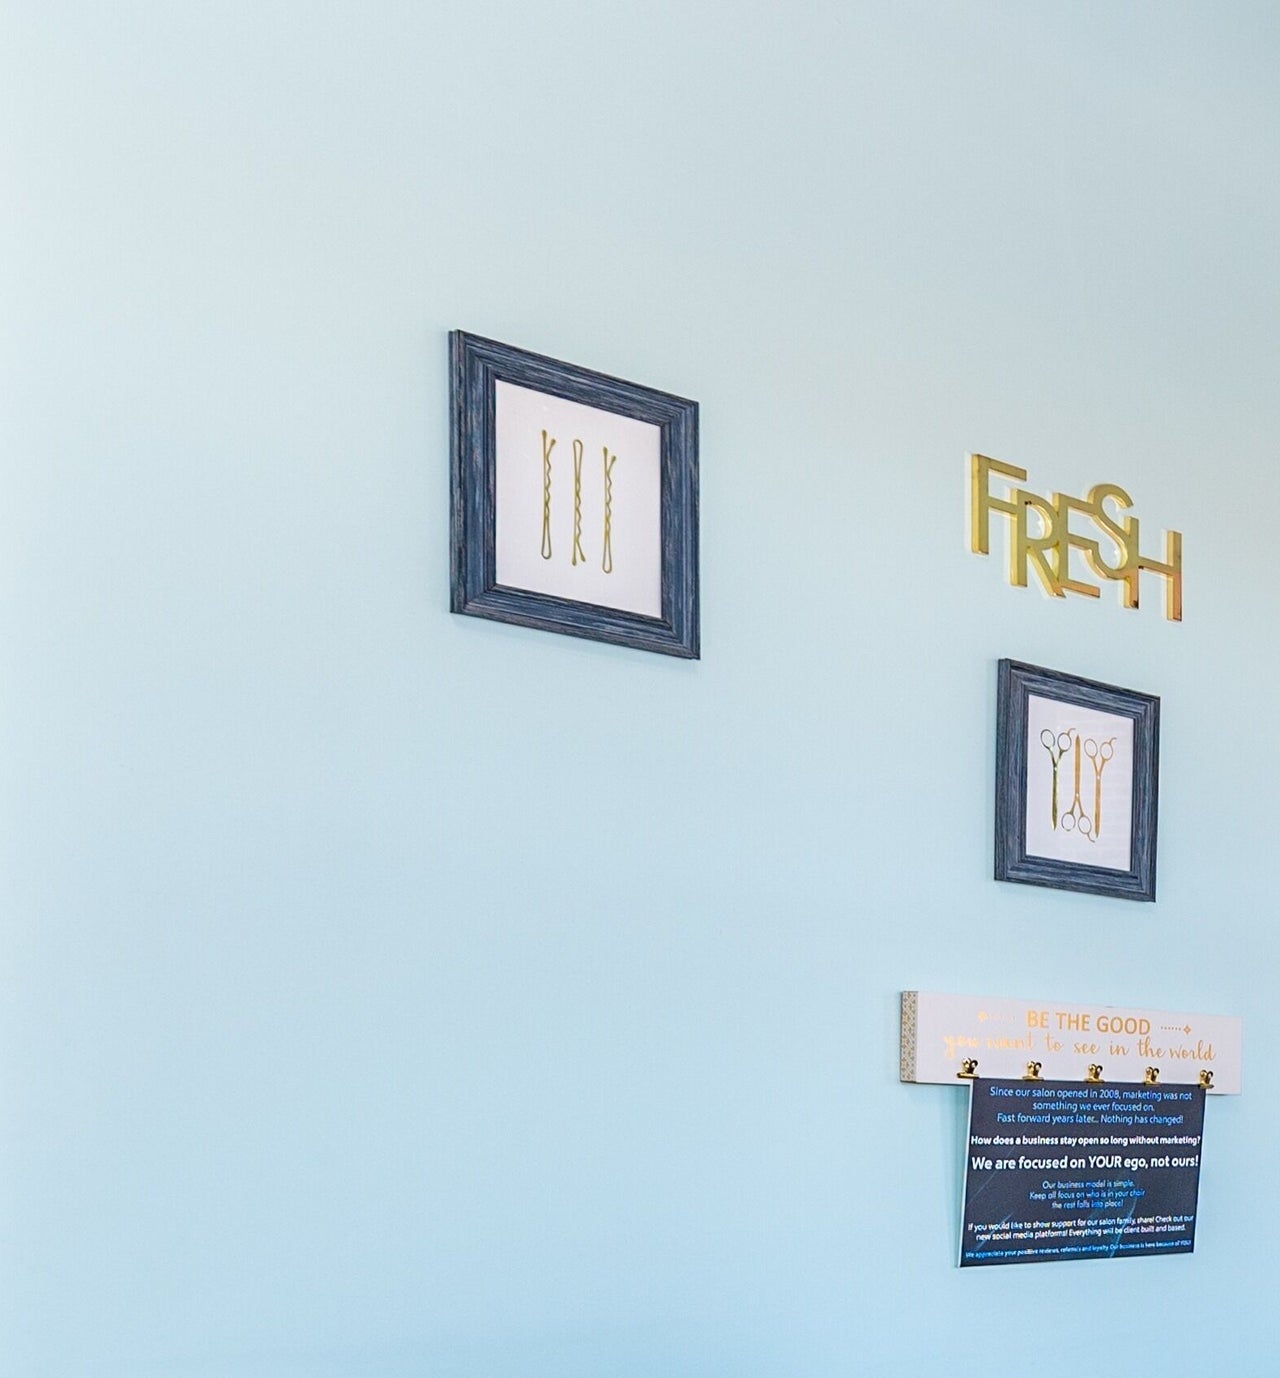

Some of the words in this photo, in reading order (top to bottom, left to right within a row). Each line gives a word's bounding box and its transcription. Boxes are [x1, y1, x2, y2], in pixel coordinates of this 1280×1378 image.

[971, 453, 1183, 622] FRESH
[1027, 1010, 1048, 1029] BE
[1055, 1012, 1090, 1032] THE
[1096, 1015, 1151, 1035] GOOD
[943, 1034, 979, 1059] you
[1045, 1034, 1062, 1052] to
[1074, 1040, 1099, 1055] see
[1110, 1040, 1129, 1057] in
[1137, 1036, 1166, 1058] the
[1166, 1040, 1216, 1061] world
[990, 1086, 1014, 1097] Since
[1015, 1088, 1030, 1097] our
[1032, 1088, 1056, 1097] salon
[1057, 1088, 1088, 1100] opened
[1090, 1089, 1098, 1098] in
[1100, 1089, 1121, 1100] 2008,
[1122, 1090, 1162, 1102] marketing
[1163, 1092, 1178, 1100] was
[1179, 1091, 1192, 1100] not
[1032, 1101, 1078, 1113] something
[1079, 1103, 1091, 1111] we
[1093, 1103, 1110, 1111] ever
[1112, 1102, 1142, 1111] focused
[997, 1113, 1016, 1123] Fast
[1017, 1113, 1050, 1123] forward
[1052, 1115, 1074, 1125] years
[1101, 1114, 1133, 1125] Nothing
[1134, 1115, 1151, 1124] has
[1150, 1115, 1184, 1126] changed!
[971, 1136, 992, 1145] How
[993, 1135, 1014, 1145] does
[1015, 1137, 1021, 1145] a
[1022, 1135, 1059, 1145] business
[1060, 1136, 1077, 1147] stay
[1078, 1137, 1099, 1147] open
[1100, 1137, 1110, 1145] so
[1110, 1136, 1128, 1147] long
[1129, 1136, 1159, 1145] without
[1160, 1136, 1200, 1147] marketing?
[972, 1156, 993, 1170] We
[995, 1159, 1016, 1170] are
[1018, 1155, 1069, 1170] focused
[1070, 1159, 1086, 1169] on
[1088, 1155, 1122, 1169] YOUR
[1124, 1158, 1149, 1171] ego,
[1150, 1156, 1170, 1167] not
[1172, 1154, 1199, 1167] ours!
[1042, 1180, 1057, 1189] Our
[1057, 1180, 1085, 1189] business
[1086, 1180, 1106, 1188] model
[1030, 1191, 1047, 1201] Keep
[1048, 1190, 1057, 1199] all
[1058, 1190, 1075, 1199] focus
[1114, 1191, 1129, 1199] your
[968, 1222, 974, 1231] If
[974, 1224, 987, 1233] you
[988, 1222, 1010, 1231] would
[1010, 1222, 1023, 1230] like
[1033, 1220, 1051, 1229] show
[1051, 1220, 1076, 1229] support
[1077, 1218, 1087, 1227] for
[1099, 1218, 1116, 1226] salon
[1155, 1215, 1172, 1223] Check
[992, 1232, 1011, 1241] social
[1012, 1231, 1033, 1240] media
[1068, 1227, 1102, 1238] Everything
[1124, 1225, 1140, 1234] client
[1156, 1224, 1167, 1232] and
